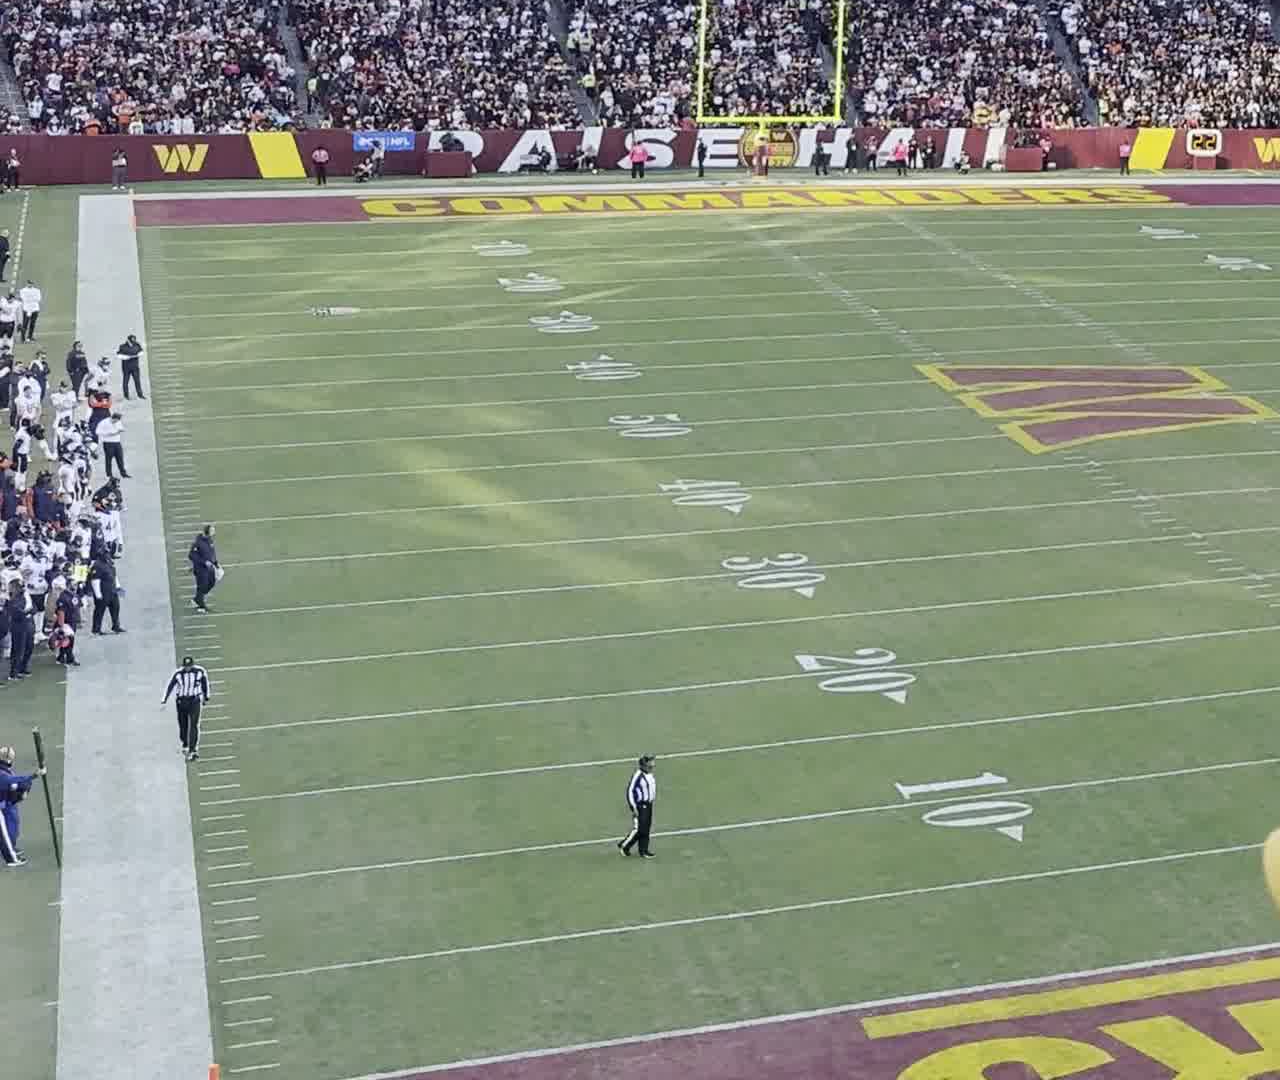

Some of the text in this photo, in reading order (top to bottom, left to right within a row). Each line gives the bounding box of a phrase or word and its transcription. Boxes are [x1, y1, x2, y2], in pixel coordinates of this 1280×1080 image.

[361, 187, 1172, 216] COMMANDERS
[609, 412, 693, 438] 50
[656, 480, 752, 506] 40
[721, 552, 826, 589] 30
[794, 648, 917, 693] 20
[896, 772, 1033, 827] 10
